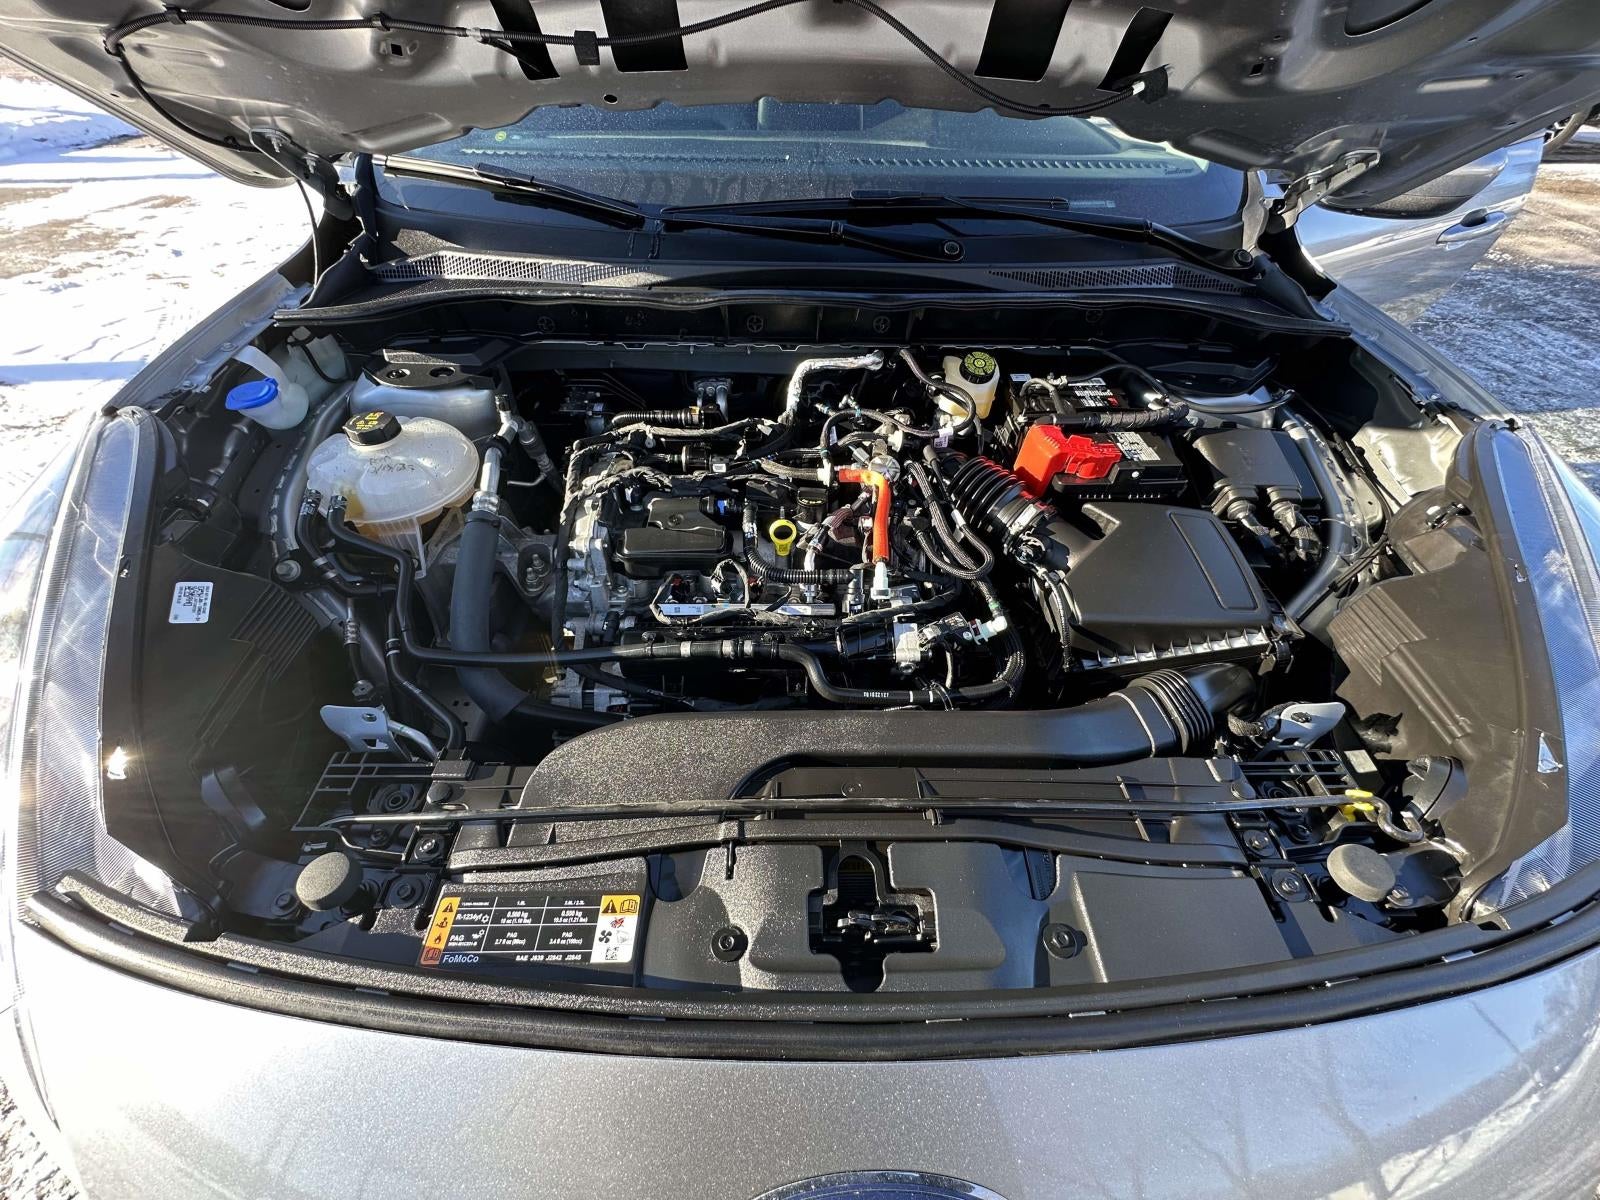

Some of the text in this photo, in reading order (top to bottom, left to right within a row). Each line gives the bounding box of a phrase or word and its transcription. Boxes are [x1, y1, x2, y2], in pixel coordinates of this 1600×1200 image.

[455, 913, 483, 922] R-1234yf
[449, 934, 465, 942] PAG
[442, 954, 479, 963] FoMoCo
